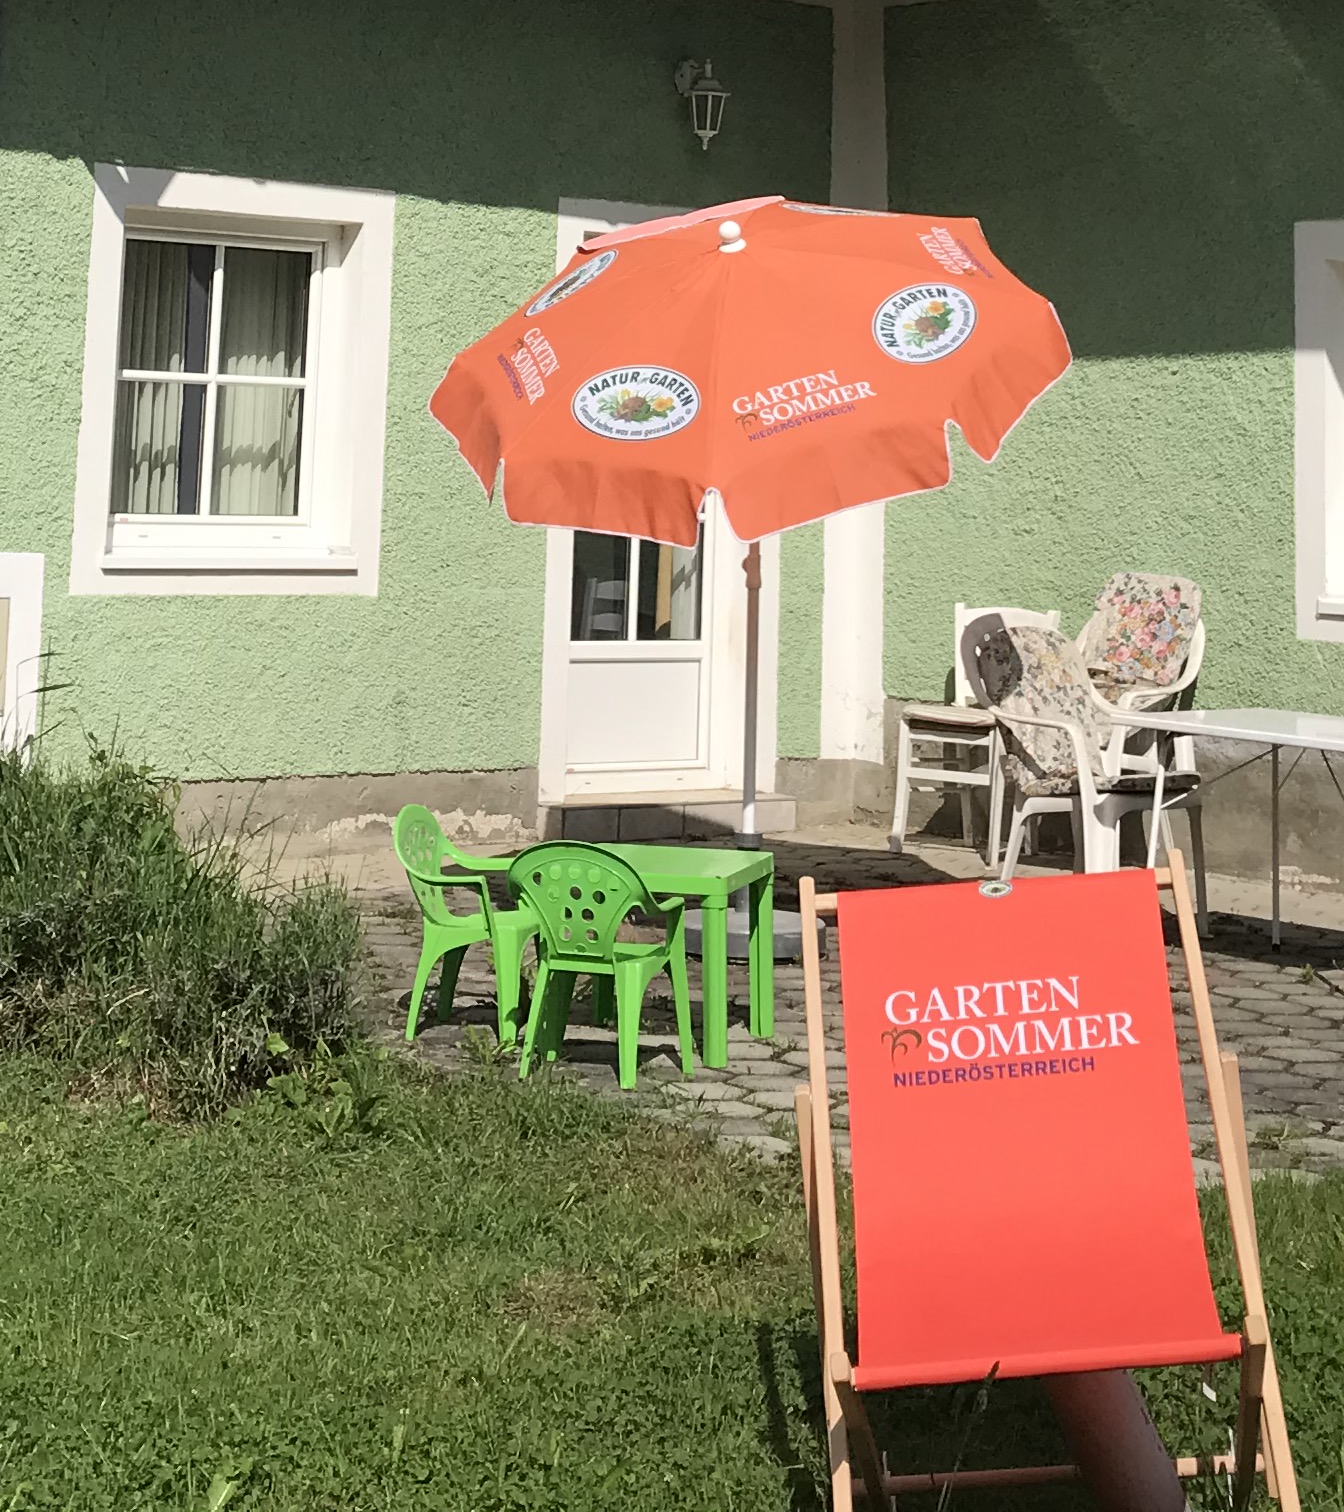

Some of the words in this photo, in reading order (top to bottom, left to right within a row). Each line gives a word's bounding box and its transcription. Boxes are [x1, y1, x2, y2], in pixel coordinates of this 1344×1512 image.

[880, 312, 900, 347] NATUR
[892, 288, 948, 310] GARTEN
[524, 327, 560, 378] GARTEN
[511, 348, 545, 405] SOMMER
[588, 371, 640, 396] NATUR
[649, 372, 694, 407] GARTEN
[732, 370, 839, 414] GARTEN
[748, 404, 856, 442] NIEDERÖSTERREICH
[759, 381, 877, 426] SOMMER
[884, 976, 1079, 1025] GARTEN
[927, 1012, 1140, 1063] SOMMER
[893, 1056, 1095, 1088] NIEDERÖSTERREICH
